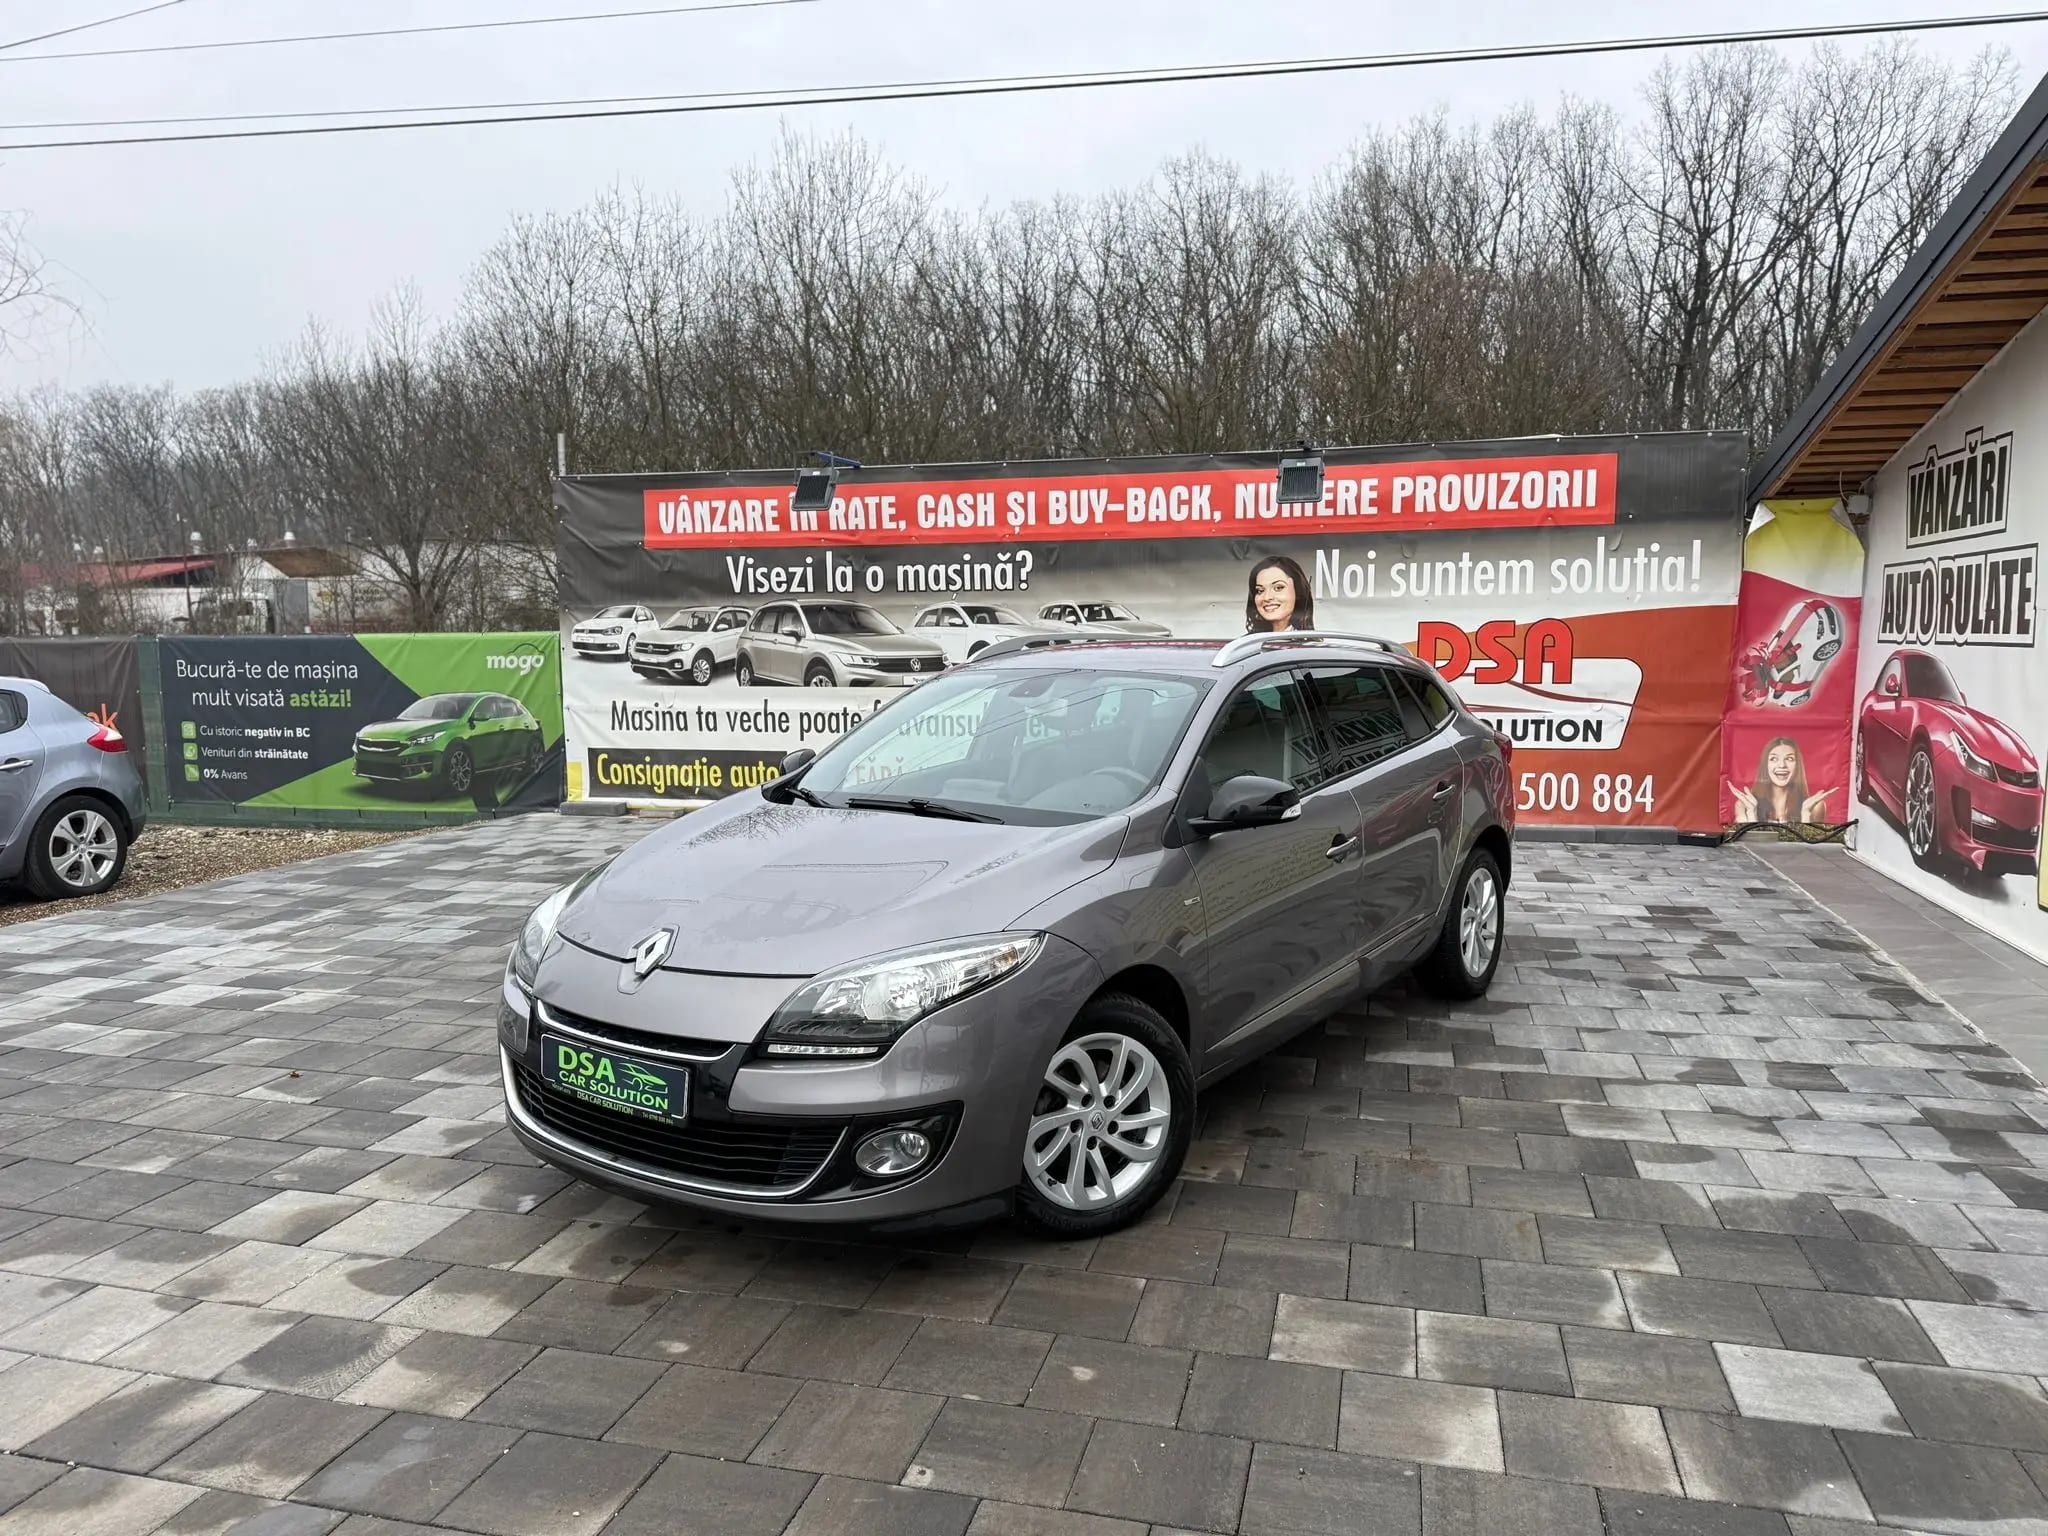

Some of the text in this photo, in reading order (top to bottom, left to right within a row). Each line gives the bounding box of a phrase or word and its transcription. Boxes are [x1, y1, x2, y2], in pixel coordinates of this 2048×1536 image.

[658, 495, 781, 533] VÂNZARE
[829, 495, 907, 532] RATE,
[917, 493, 995, 528] CASH
[1006, 490, 1036, 534] ȘI
[1048, 484, 1222, 525] BUY-BACK,
[1392, 468, 1598, 514] PROVIZORII
[1909, 439, 2008, 539] VÂNZĂRI
[726, 550, 1034, 600] Visezi la o mașină?
[1315, 536, 1702, 604] Noi suntem soluția!
[1881, 557, 2033, 636] AUTO RULATE
[176, 659, 358, 683] Bucură-te de mașina
[486, 655, 544, 676] mogo
[1417, 617, 1574, 684] DSA
[192, 688, 352, 708] mult visată astăzi!
[200, 726, 214, 737] Cu
[215, 726, 242, 737] istoric
[245, 727, 282, 740] negativ
[296, 727, 311, 738] BC
[696, 705, 718, 732] ta
[726, 699, 790, 733] veche
[800, 706, 862, 741] poate
[201, 747, 236, 758] Venituri
[238, 747, 253, 758] din
[203, 768, 248, 780] 0% Avans
[597, 752, 722, 795] Consignație
[730, 761, 780, 787] auto
[1516, 772, 1655, 813] 500 884
[558, 1045, 616, 1084] DSA
[559, 1070, 586, 1088] CAR
[589, 1079, 669, 1110] SOLUTION
